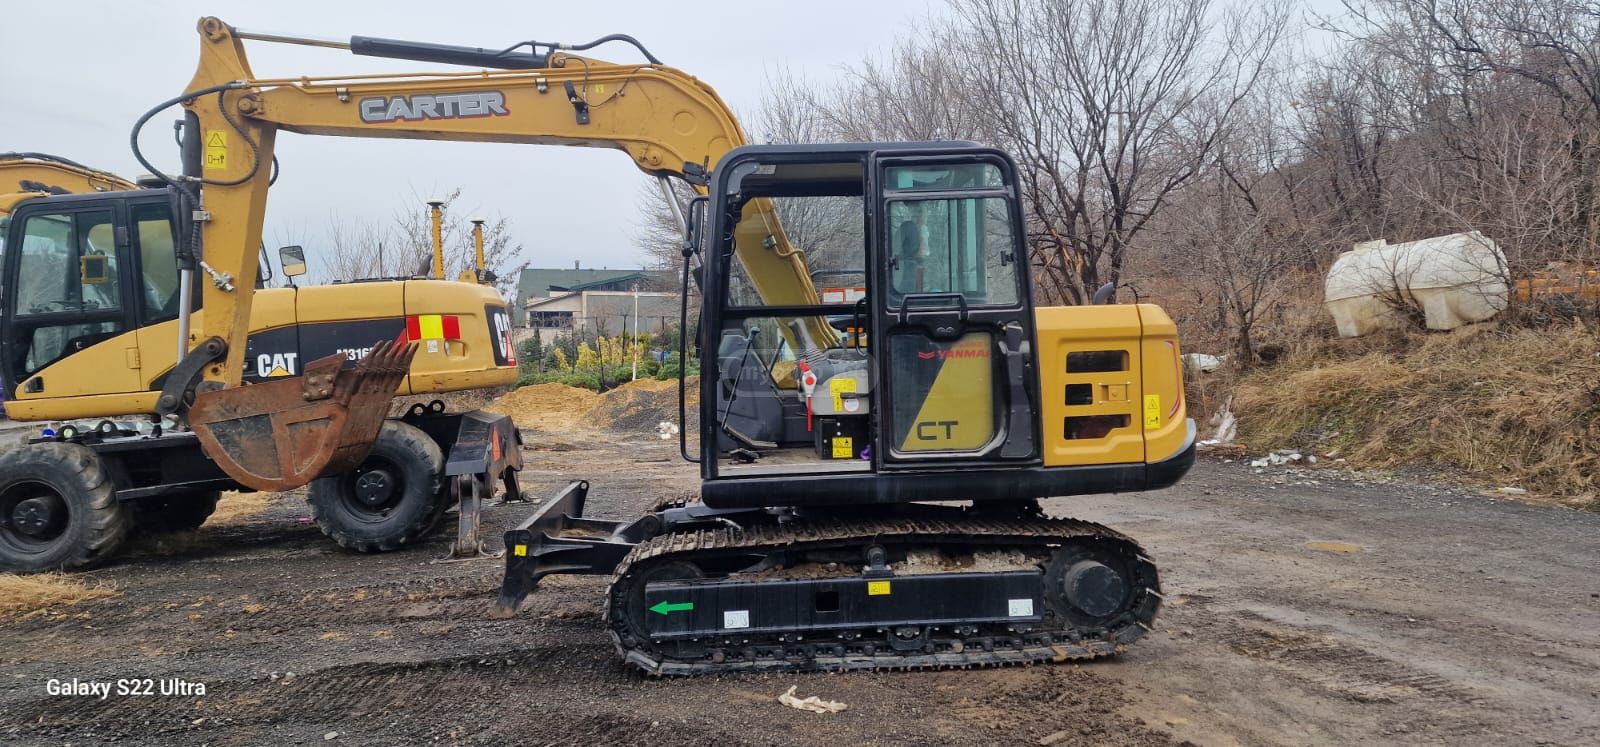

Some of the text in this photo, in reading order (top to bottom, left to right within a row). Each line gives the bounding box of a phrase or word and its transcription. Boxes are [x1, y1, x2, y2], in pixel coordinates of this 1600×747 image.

[360, 91, 508, 122] CARTER
[257, 353, 297, 377] CAT
[917, 421, 959, 440] CT
